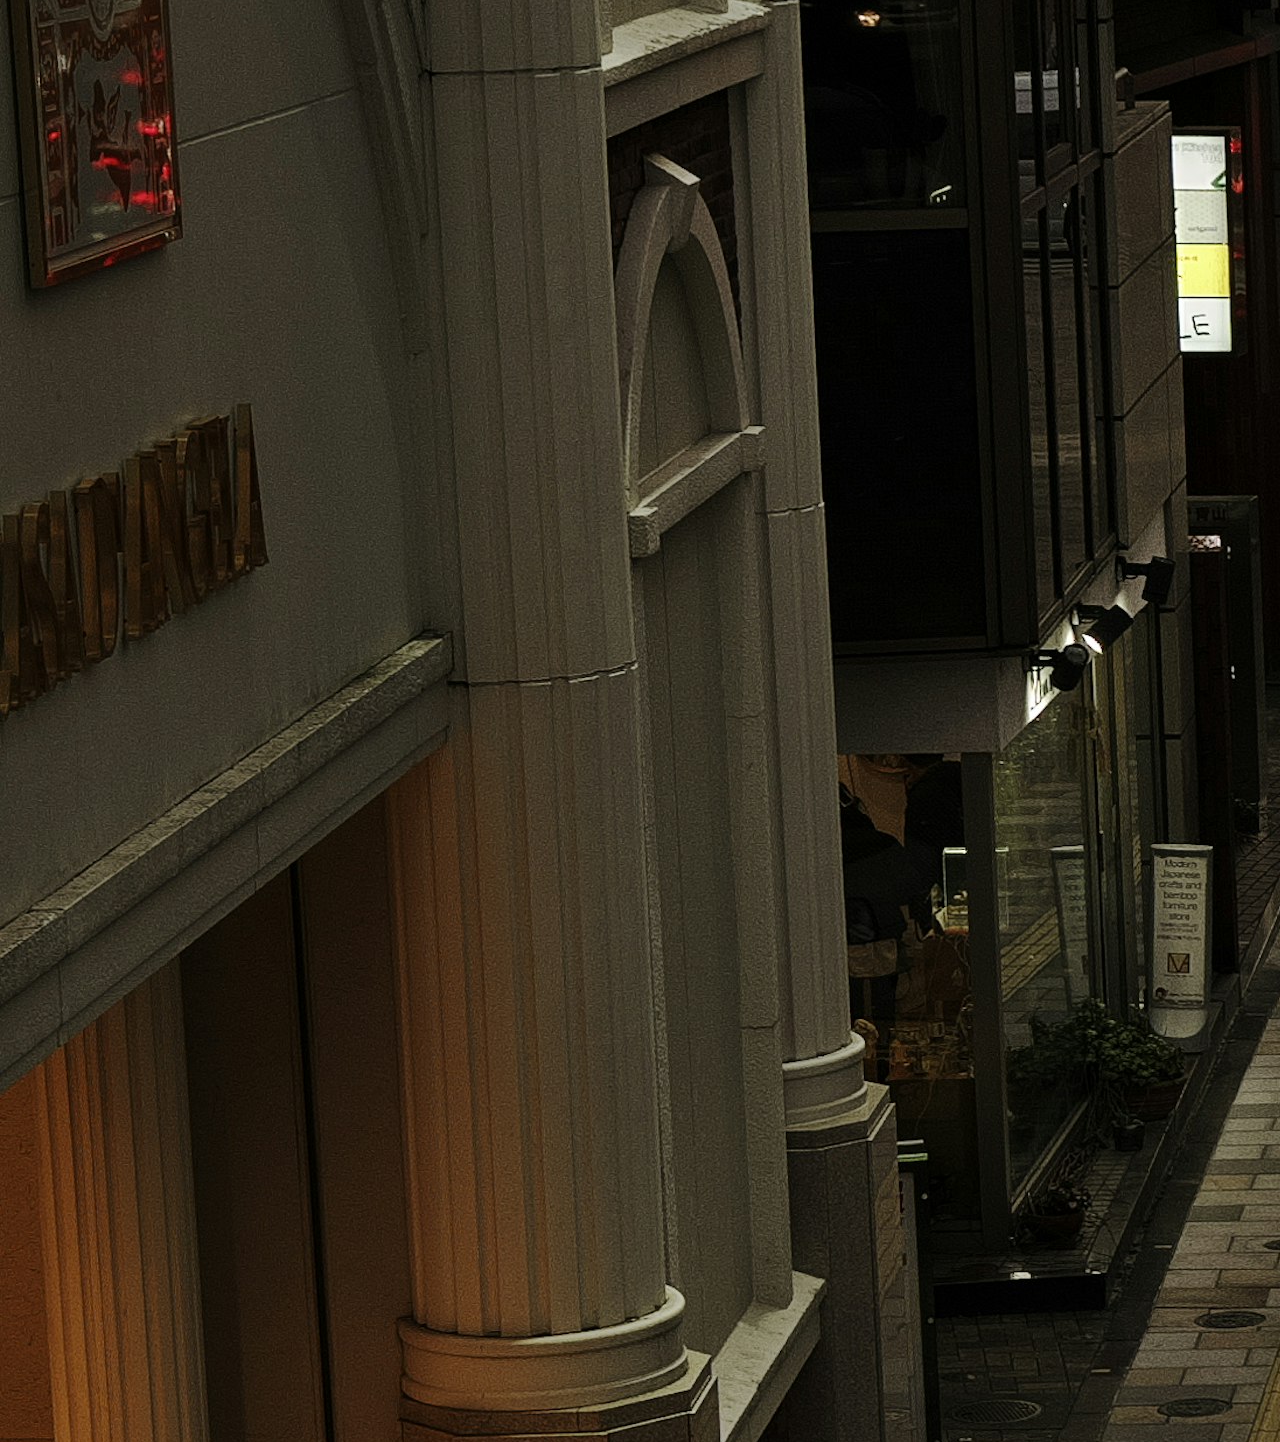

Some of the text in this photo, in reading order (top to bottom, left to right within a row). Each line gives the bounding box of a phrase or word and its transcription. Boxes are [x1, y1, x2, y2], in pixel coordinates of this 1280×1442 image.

[1160, 870, 1202, 879] Japanese
[1185, 881, 1202, 890] and
[1163, 891, 1198, 900] bamboo
